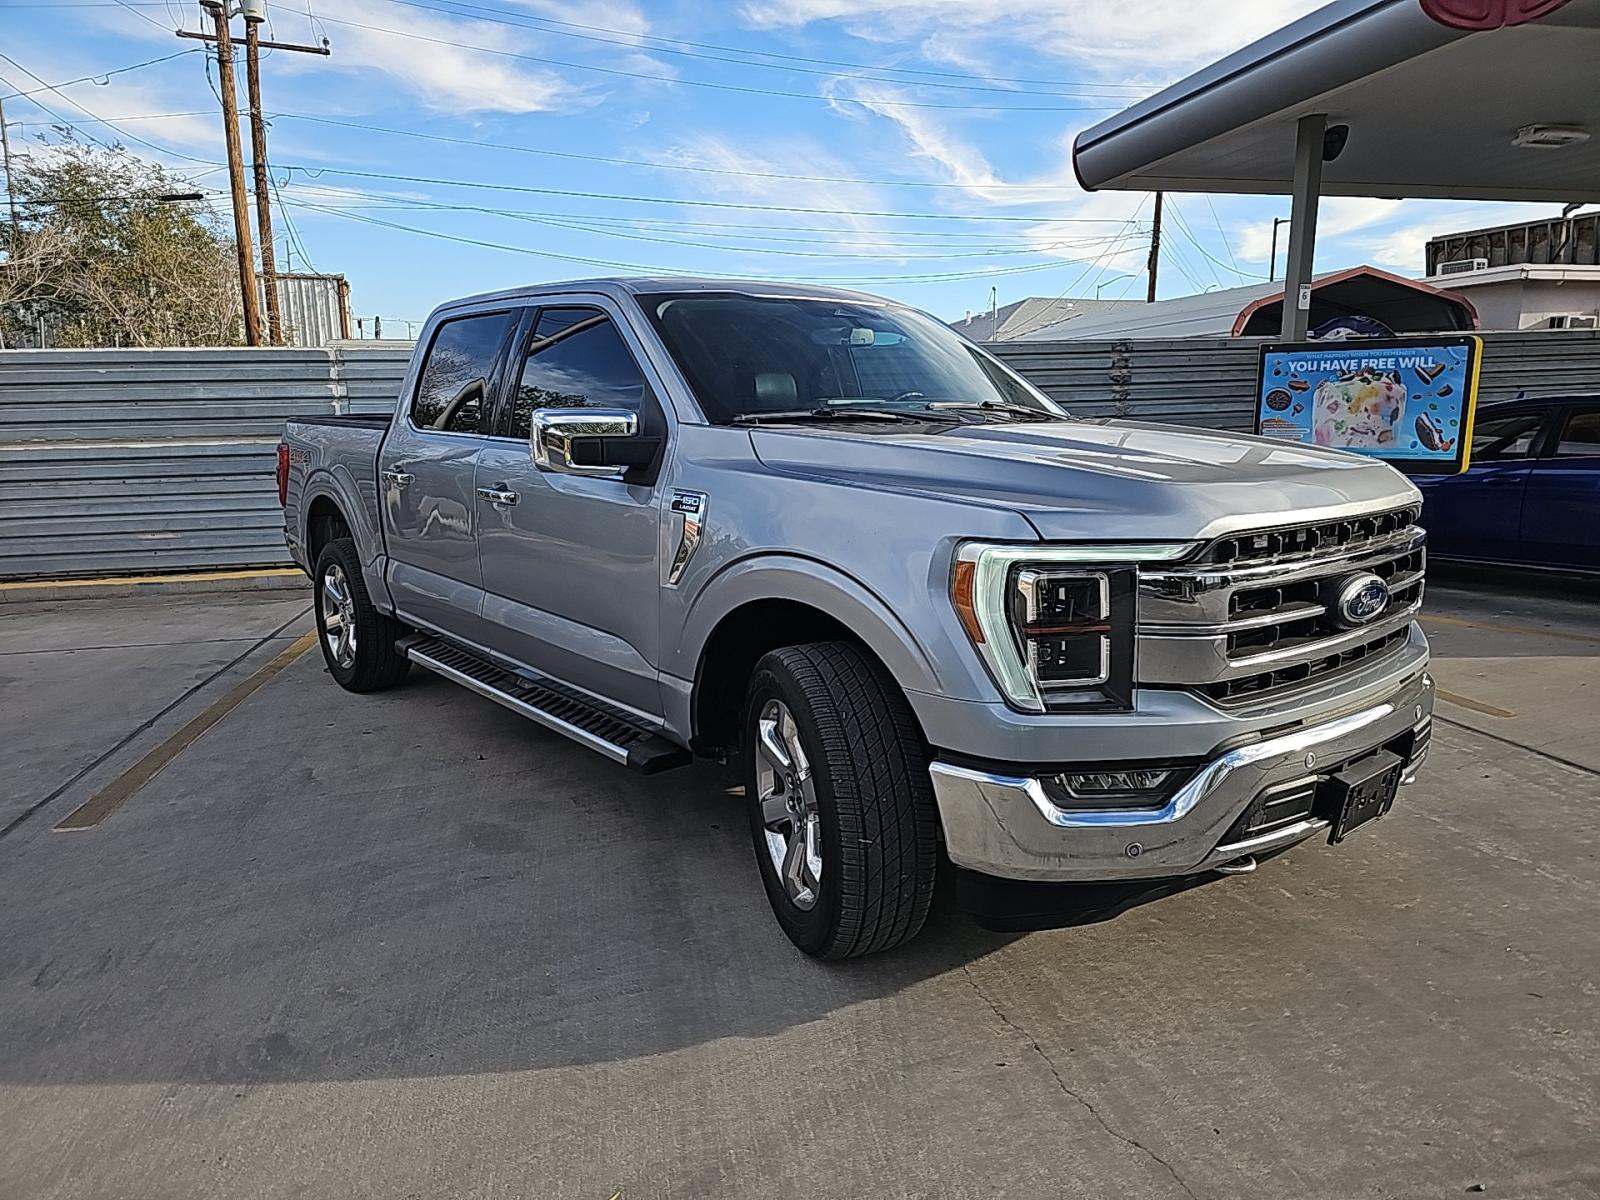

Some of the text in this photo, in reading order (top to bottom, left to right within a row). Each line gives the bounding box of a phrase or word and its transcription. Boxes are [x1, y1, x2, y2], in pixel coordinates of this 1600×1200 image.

[1302, 291, 1308, 301] 6
[1288, 356, 1436, 372] YOU HAVE FREE WILL
[672, 494, 699, 506] F-150
[1356, 588, 1382, 615] Ford
